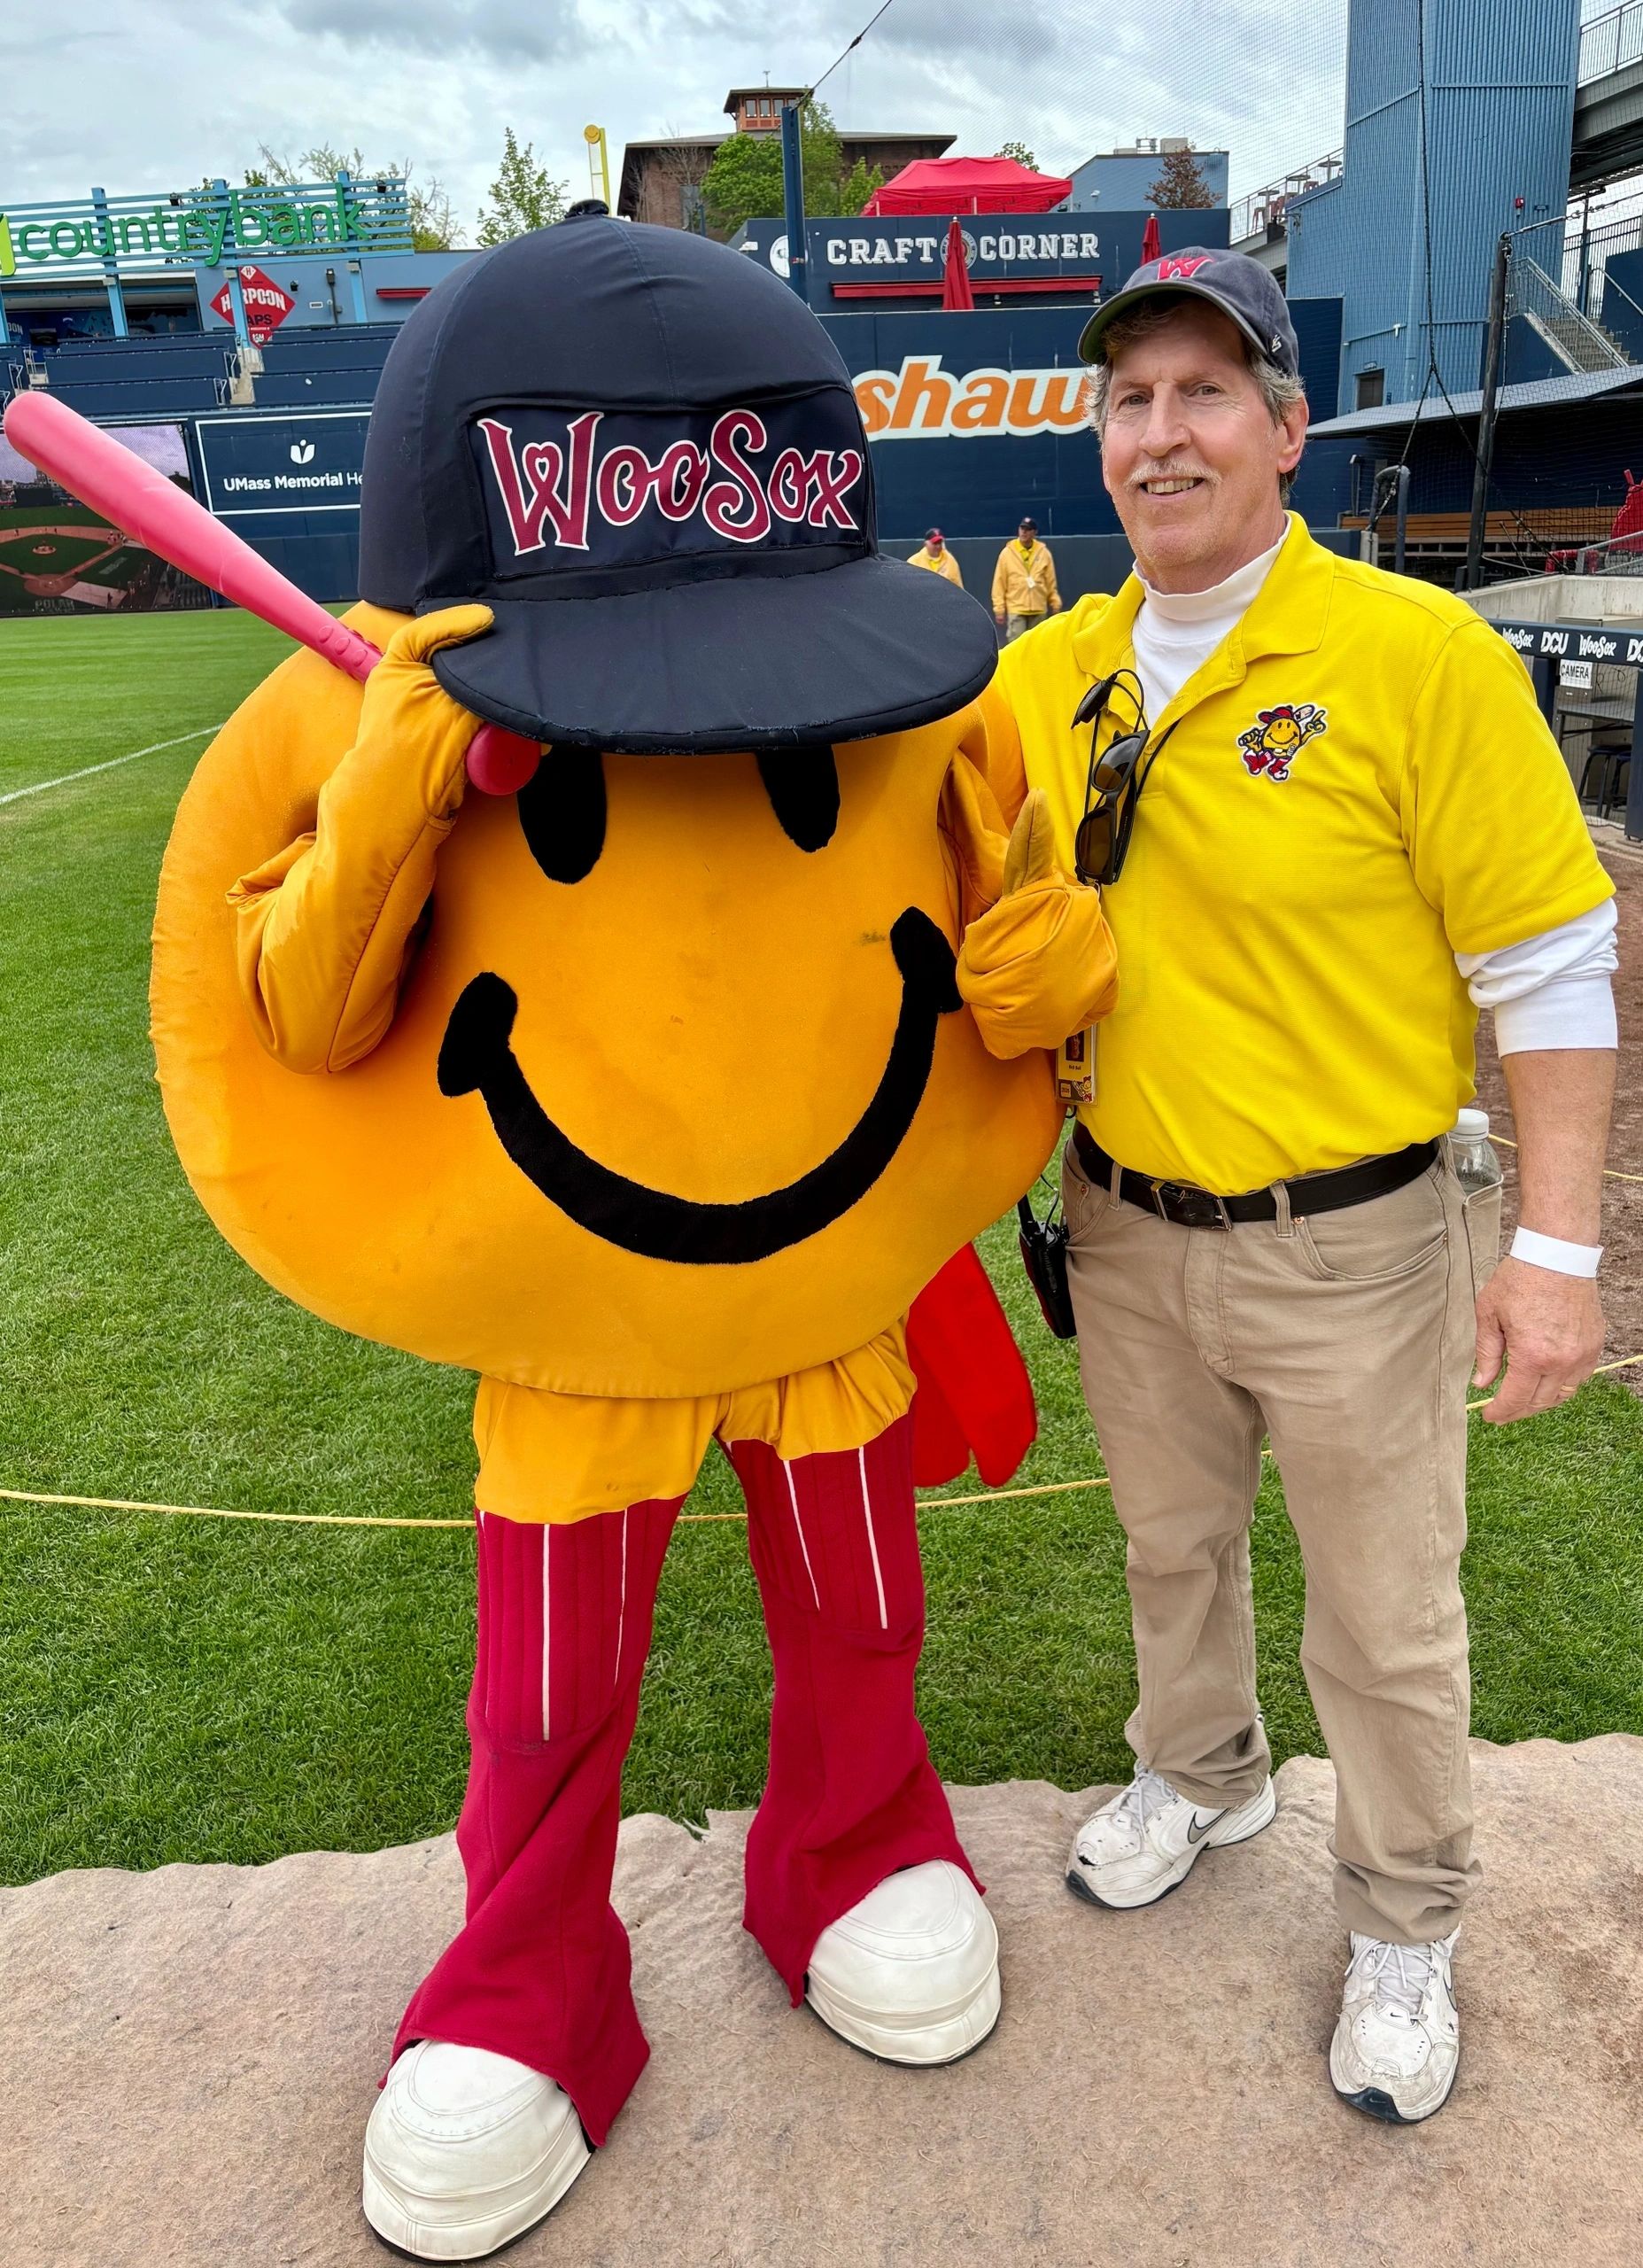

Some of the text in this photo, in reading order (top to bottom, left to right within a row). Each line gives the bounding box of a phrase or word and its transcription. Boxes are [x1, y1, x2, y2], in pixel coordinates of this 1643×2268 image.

[826, 237, 937, 265] CRAFT
[980, 233, 1100, 260] CORNER
[1158, 255, 1213, 282] W
[221, 288, 287, 313] HRPOON
[223, 477, 271, 491] UMass
[275, 472, 344, 488] Memorial
[477, 408, 863, 555] WooSox
[1540, 632, 1569, 655] DCU
[1578, 634, 1617, 658] WooSox
[1561, 664, 1589, 679] CAMERA
